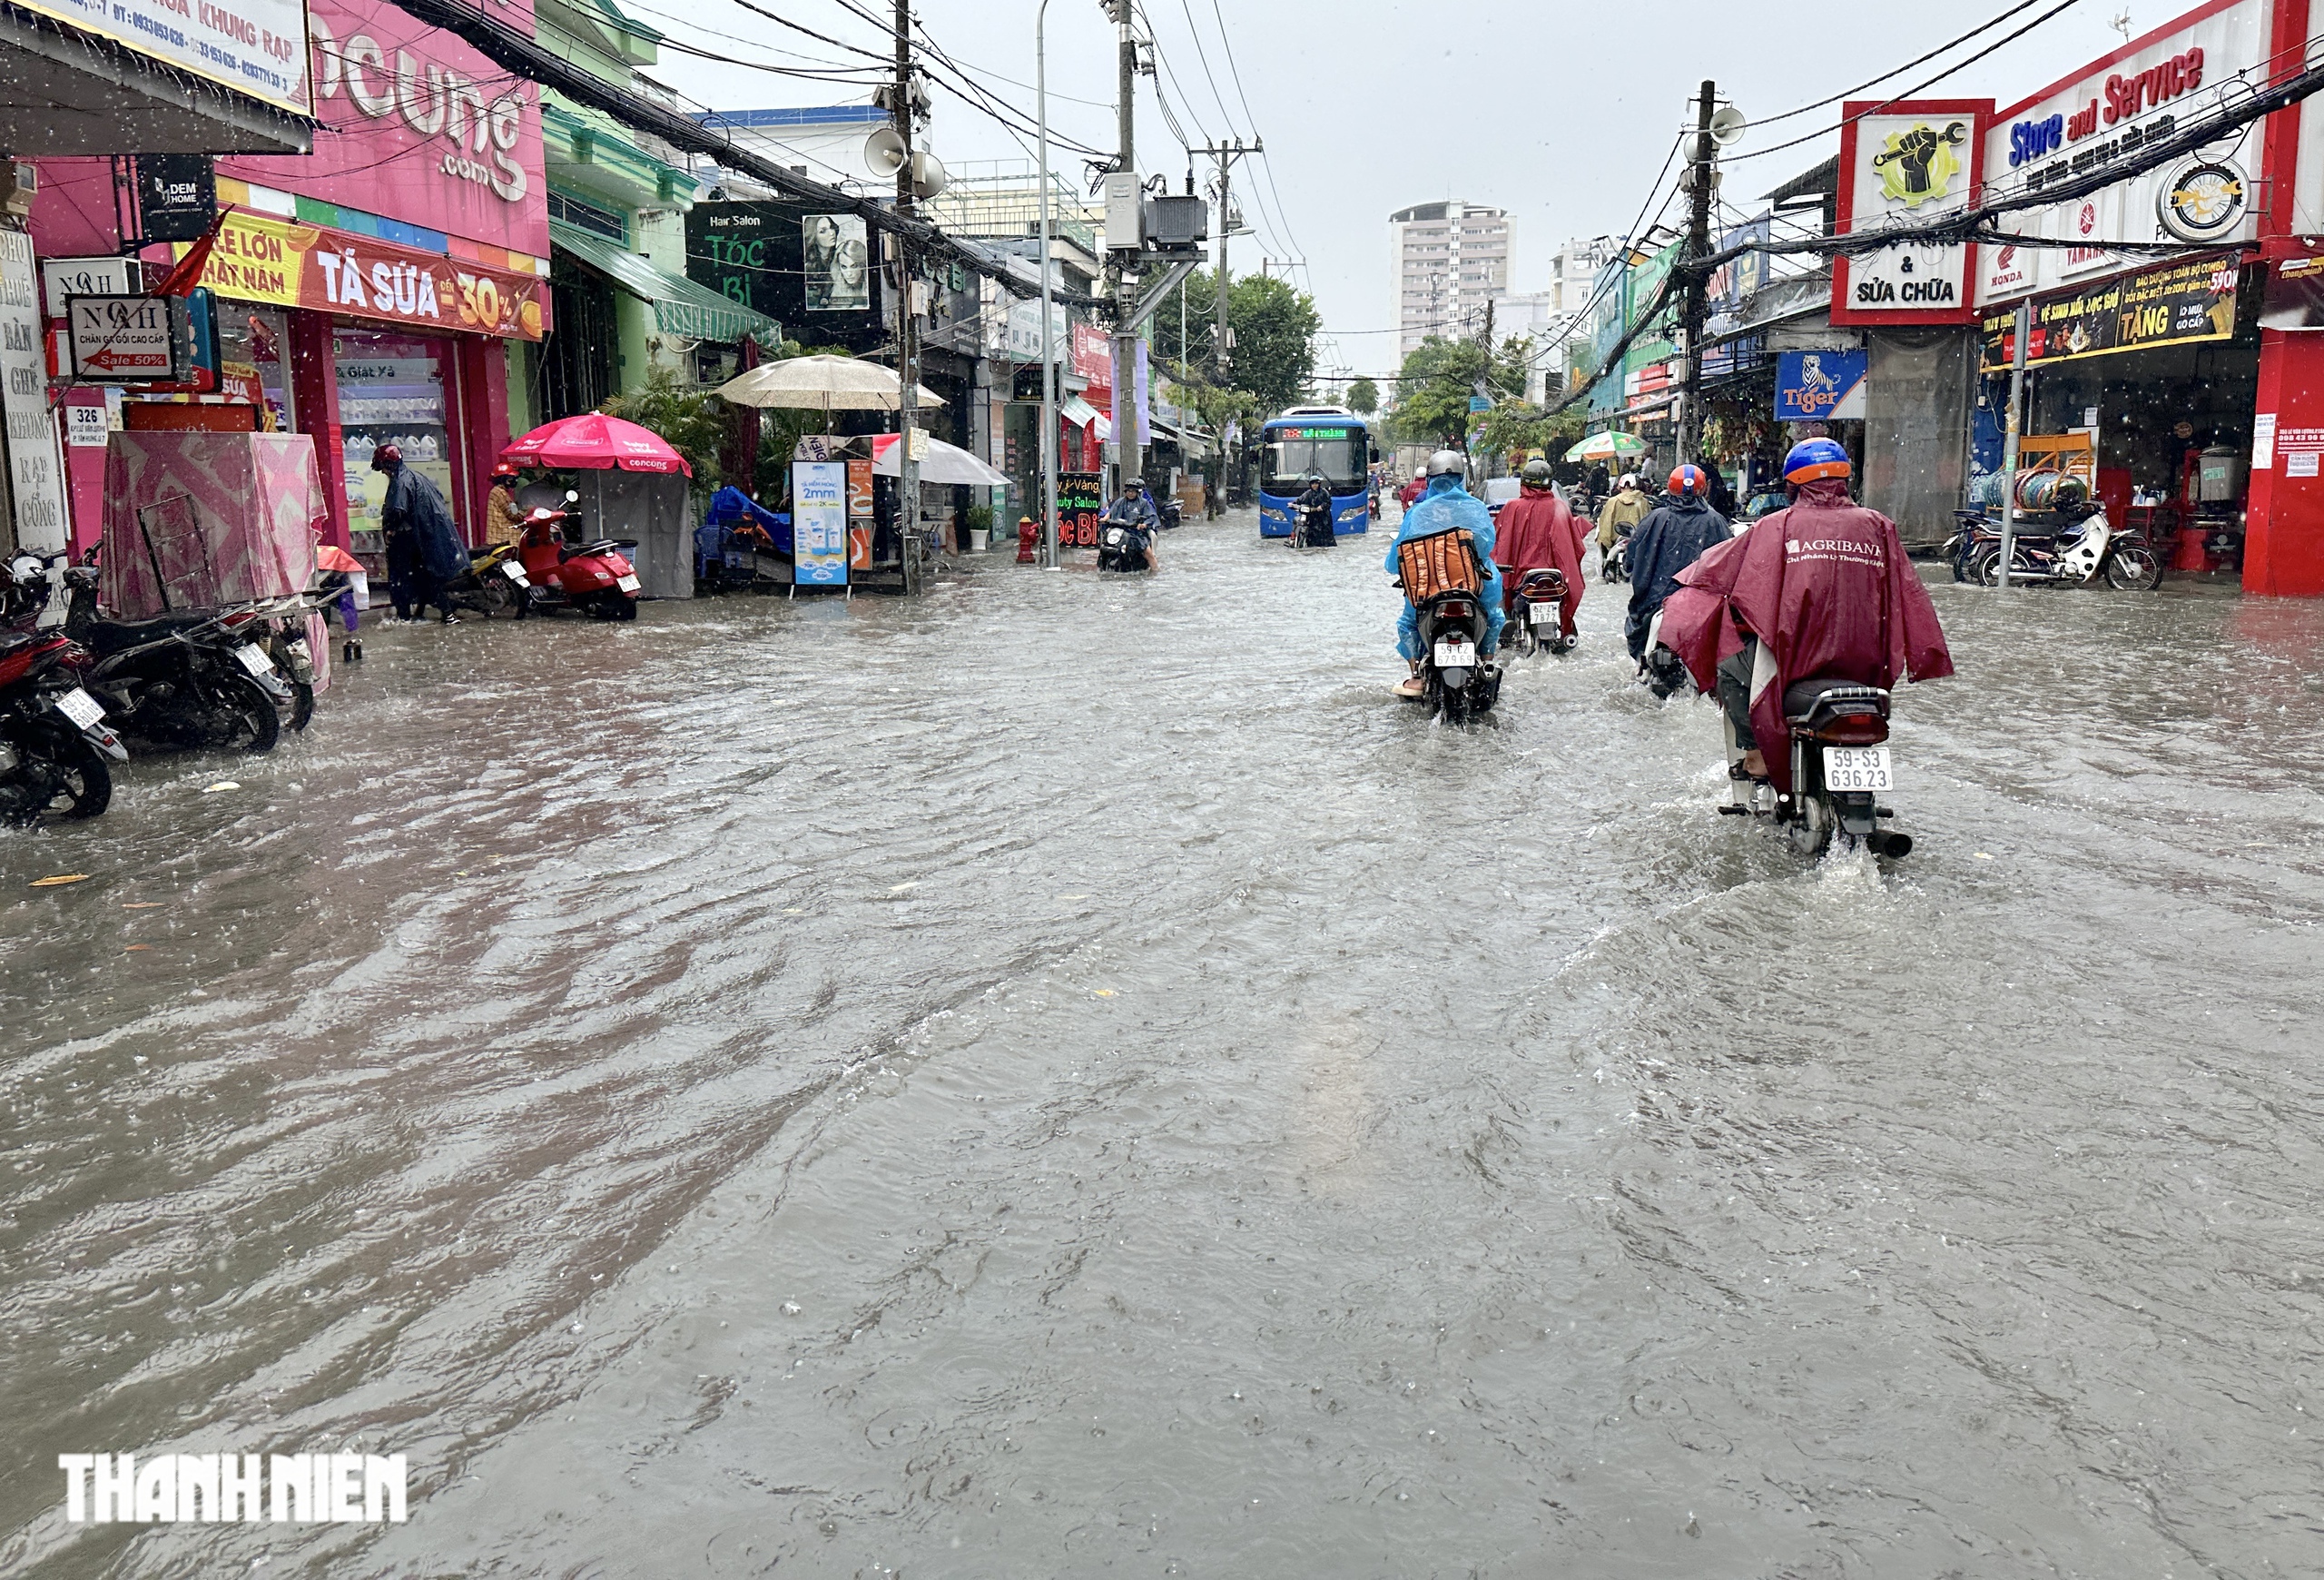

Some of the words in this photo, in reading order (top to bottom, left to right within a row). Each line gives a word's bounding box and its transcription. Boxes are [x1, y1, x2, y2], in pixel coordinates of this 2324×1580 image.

[199, 4, 256, 46] KHUNG
[262, 28, 293, 65] RẠP
[2008, 114, 2063, 167] Store
[2067, 98, 2098, 142] and
[2103, 46, 2204, 124] Service
[170, 183, 197, 194] DEM
[171, 194, 197, 203] HOME
[710, 216, 730, 227] Hair
[733, 215, 761, 227] Salon
[241, 230, 282, 263] LỚN
[1901, 256, 1913, 273] &
[2201, 260, 2227, 273] COMBO
[202, 258, 239, 287] HẤT
[243, 265, 285, 295] NĂM
[317, 247, 368, 308] TÃ
[372, 261, 440, 318] SỮA
[1991, 271, 2023, 287] HONDA
[1857, 277, 1895, 302] SỬA
[1902, 278, 1954, 301] CHỮA
[83, 301, 157, 329] NOAH
[2122, 304, 2169, 345] TẶNG
[4, 317, 32, 352] BÀN
[80, 333, 101, 344] CHĂN
[116, 332, 130, 344] GỐI
[131, 335, 147, 344] CAO
[149, 332, 164, 344] CẤP
[100, 355, 131, 365] Sale
[134, 355, 164, 366] 50%
[1783, 386, 1839, 414] Tiger
[76, 409, 98, 423] 326
[8, 411, 50, 439] KHUNG
[630, 459, 667, 470] concung
[803, 488, 835, 499] 2mm
[1074, 479, 1099, 494] Vàng
[1074, 496, 1098, 509] Salon
[1078, 512, 1098, 545] Bi
[1801, 539, 1882, 557] AGRIBANK
[1787, 554, 1799, 564] Chi
[1801, 552, 1829, 561] Nhánh
[1838, 554, 1869, 566] Thường
[1869, 558, 1885, 568] Kiệt
[1535, 613, 1556, 622] 7872
[1834, 750, 1880, 768] 59-S3
[1831, 769, 1887, 787] 636.23
